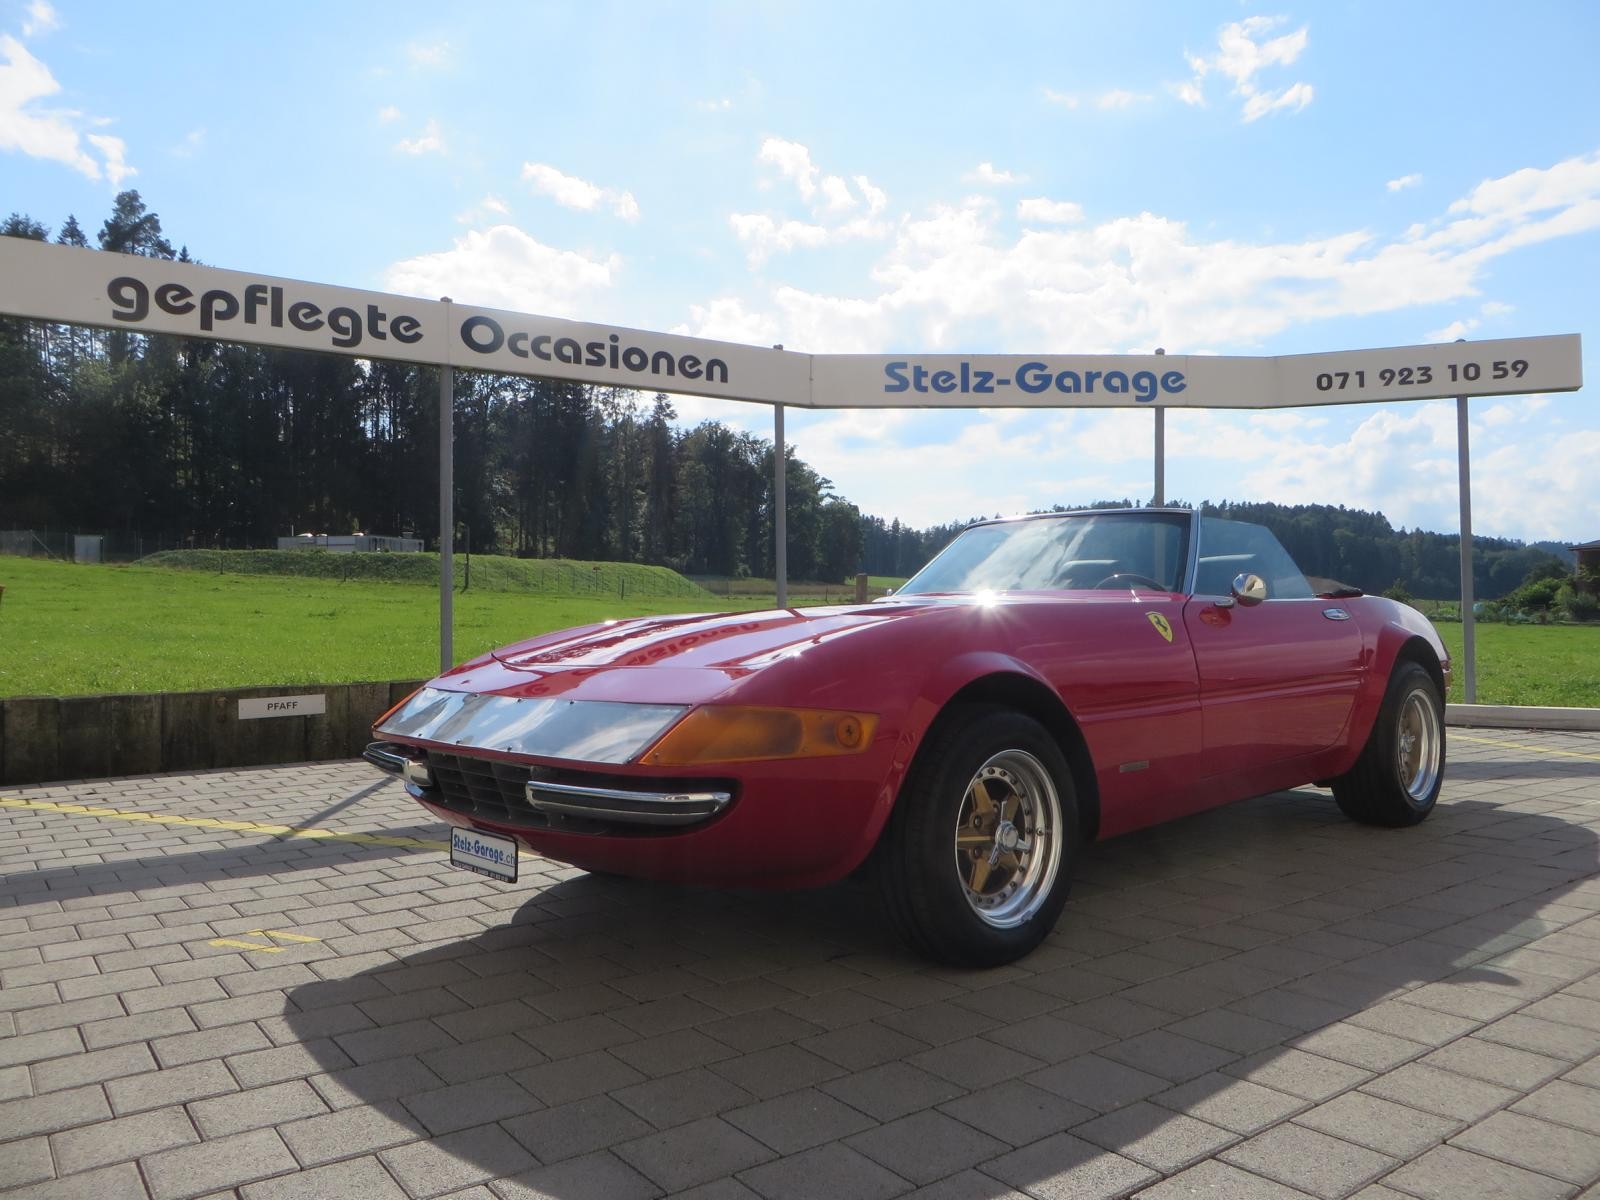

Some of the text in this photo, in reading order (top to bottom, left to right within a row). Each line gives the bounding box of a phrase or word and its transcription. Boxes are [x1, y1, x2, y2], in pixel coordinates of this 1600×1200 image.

[107, 276, 729, 383] gepflegte Occasionen
[884, 362, 1187, 402] Stelz-Garage
[1316, 360, 1529, 391] 071 923 10 59
[267, 701, 299, 710] PFAFF
[453, 834, 515, 865] Stelz-Garage.ch
